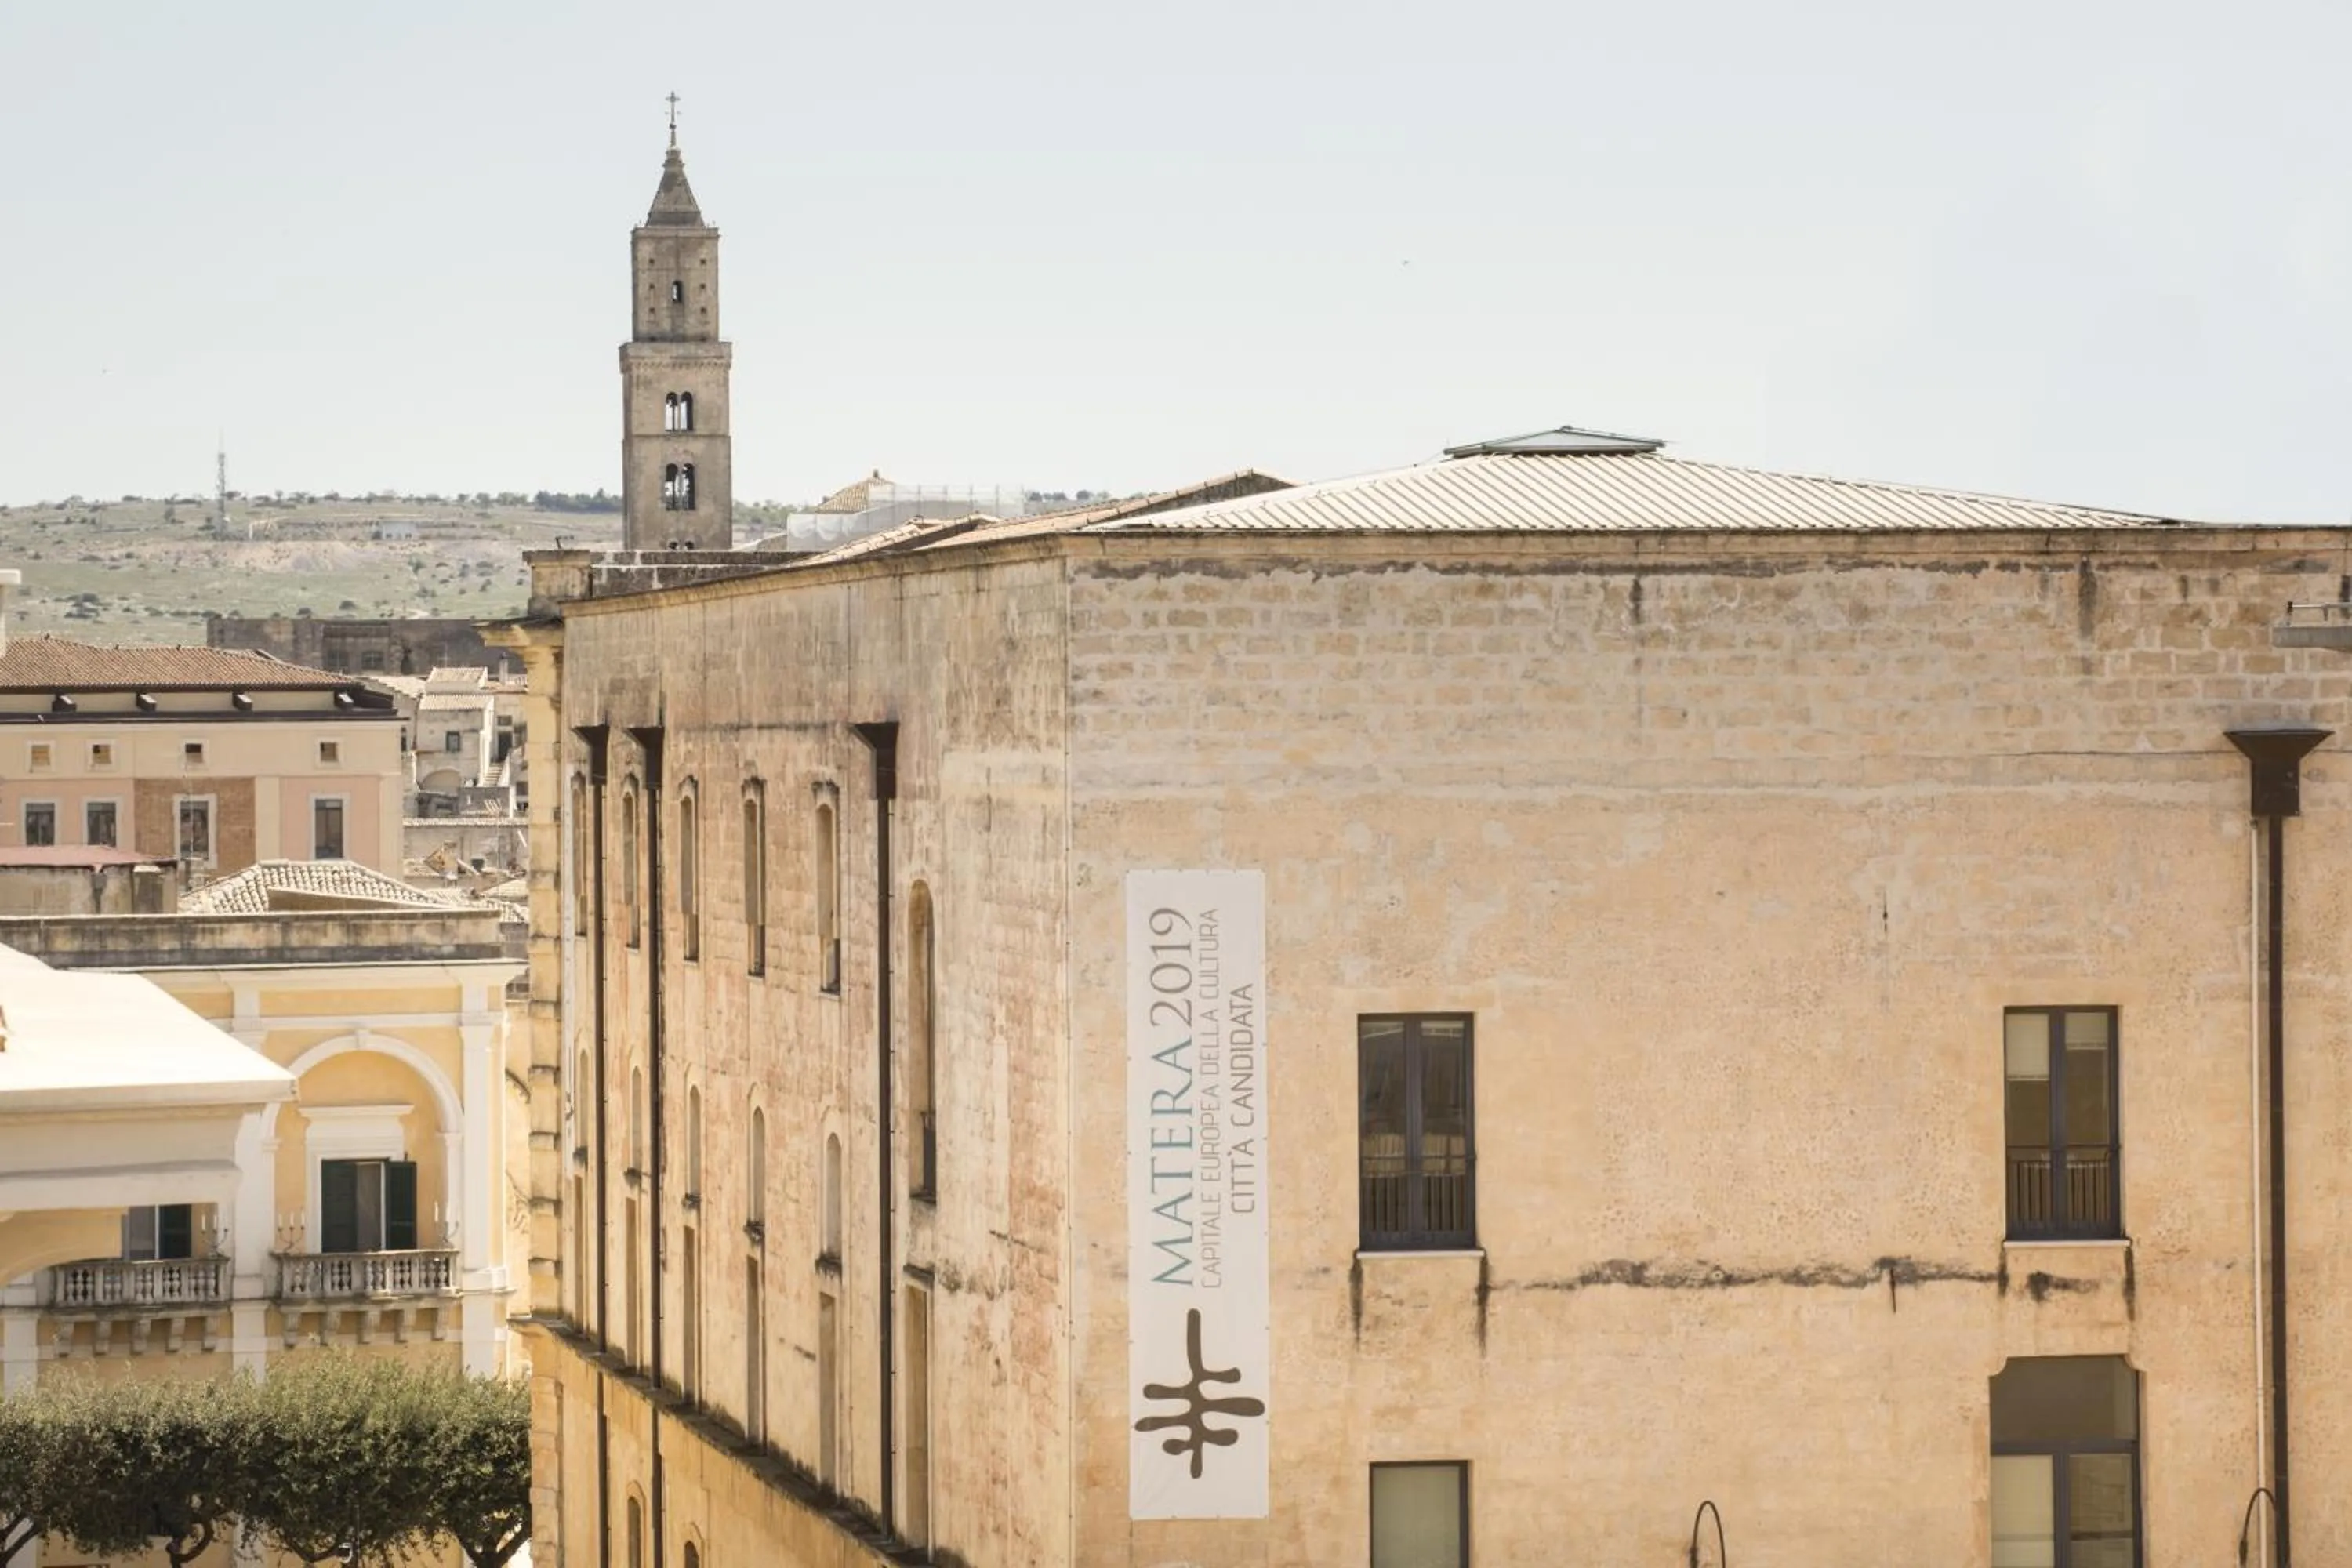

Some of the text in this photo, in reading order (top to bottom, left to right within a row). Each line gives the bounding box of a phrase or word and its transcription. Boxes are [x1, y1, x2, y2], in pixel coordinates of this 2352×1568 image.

[1149, 907, 1193, 1286] MATERA 2019
[1199, 909, 1221, 1289] CAPITALE EUROPEA DELLA CULTURA
[1227, 984, 1254, 1213] CITTÀ CANDIDATA
